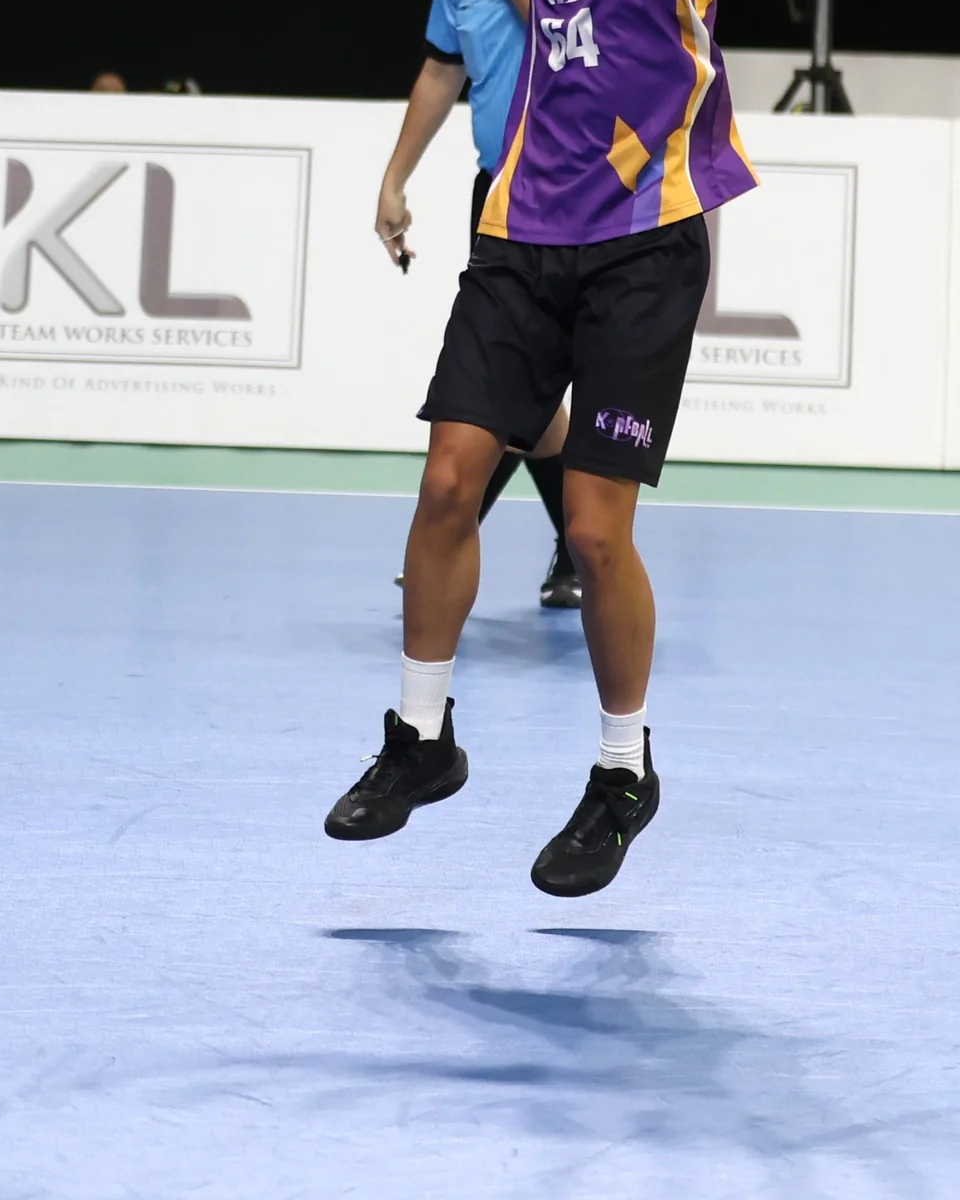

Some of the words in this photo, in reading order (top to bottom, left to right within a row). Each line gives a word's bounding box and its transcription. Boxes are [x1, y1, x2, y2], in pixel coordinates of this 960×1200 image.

[540, 7, 600, 72] 64
[64, 325, 145, 345] WORKS
[151, 327, 254, 348] SERVICES
[699, 345, 803, 367] SERVICES
